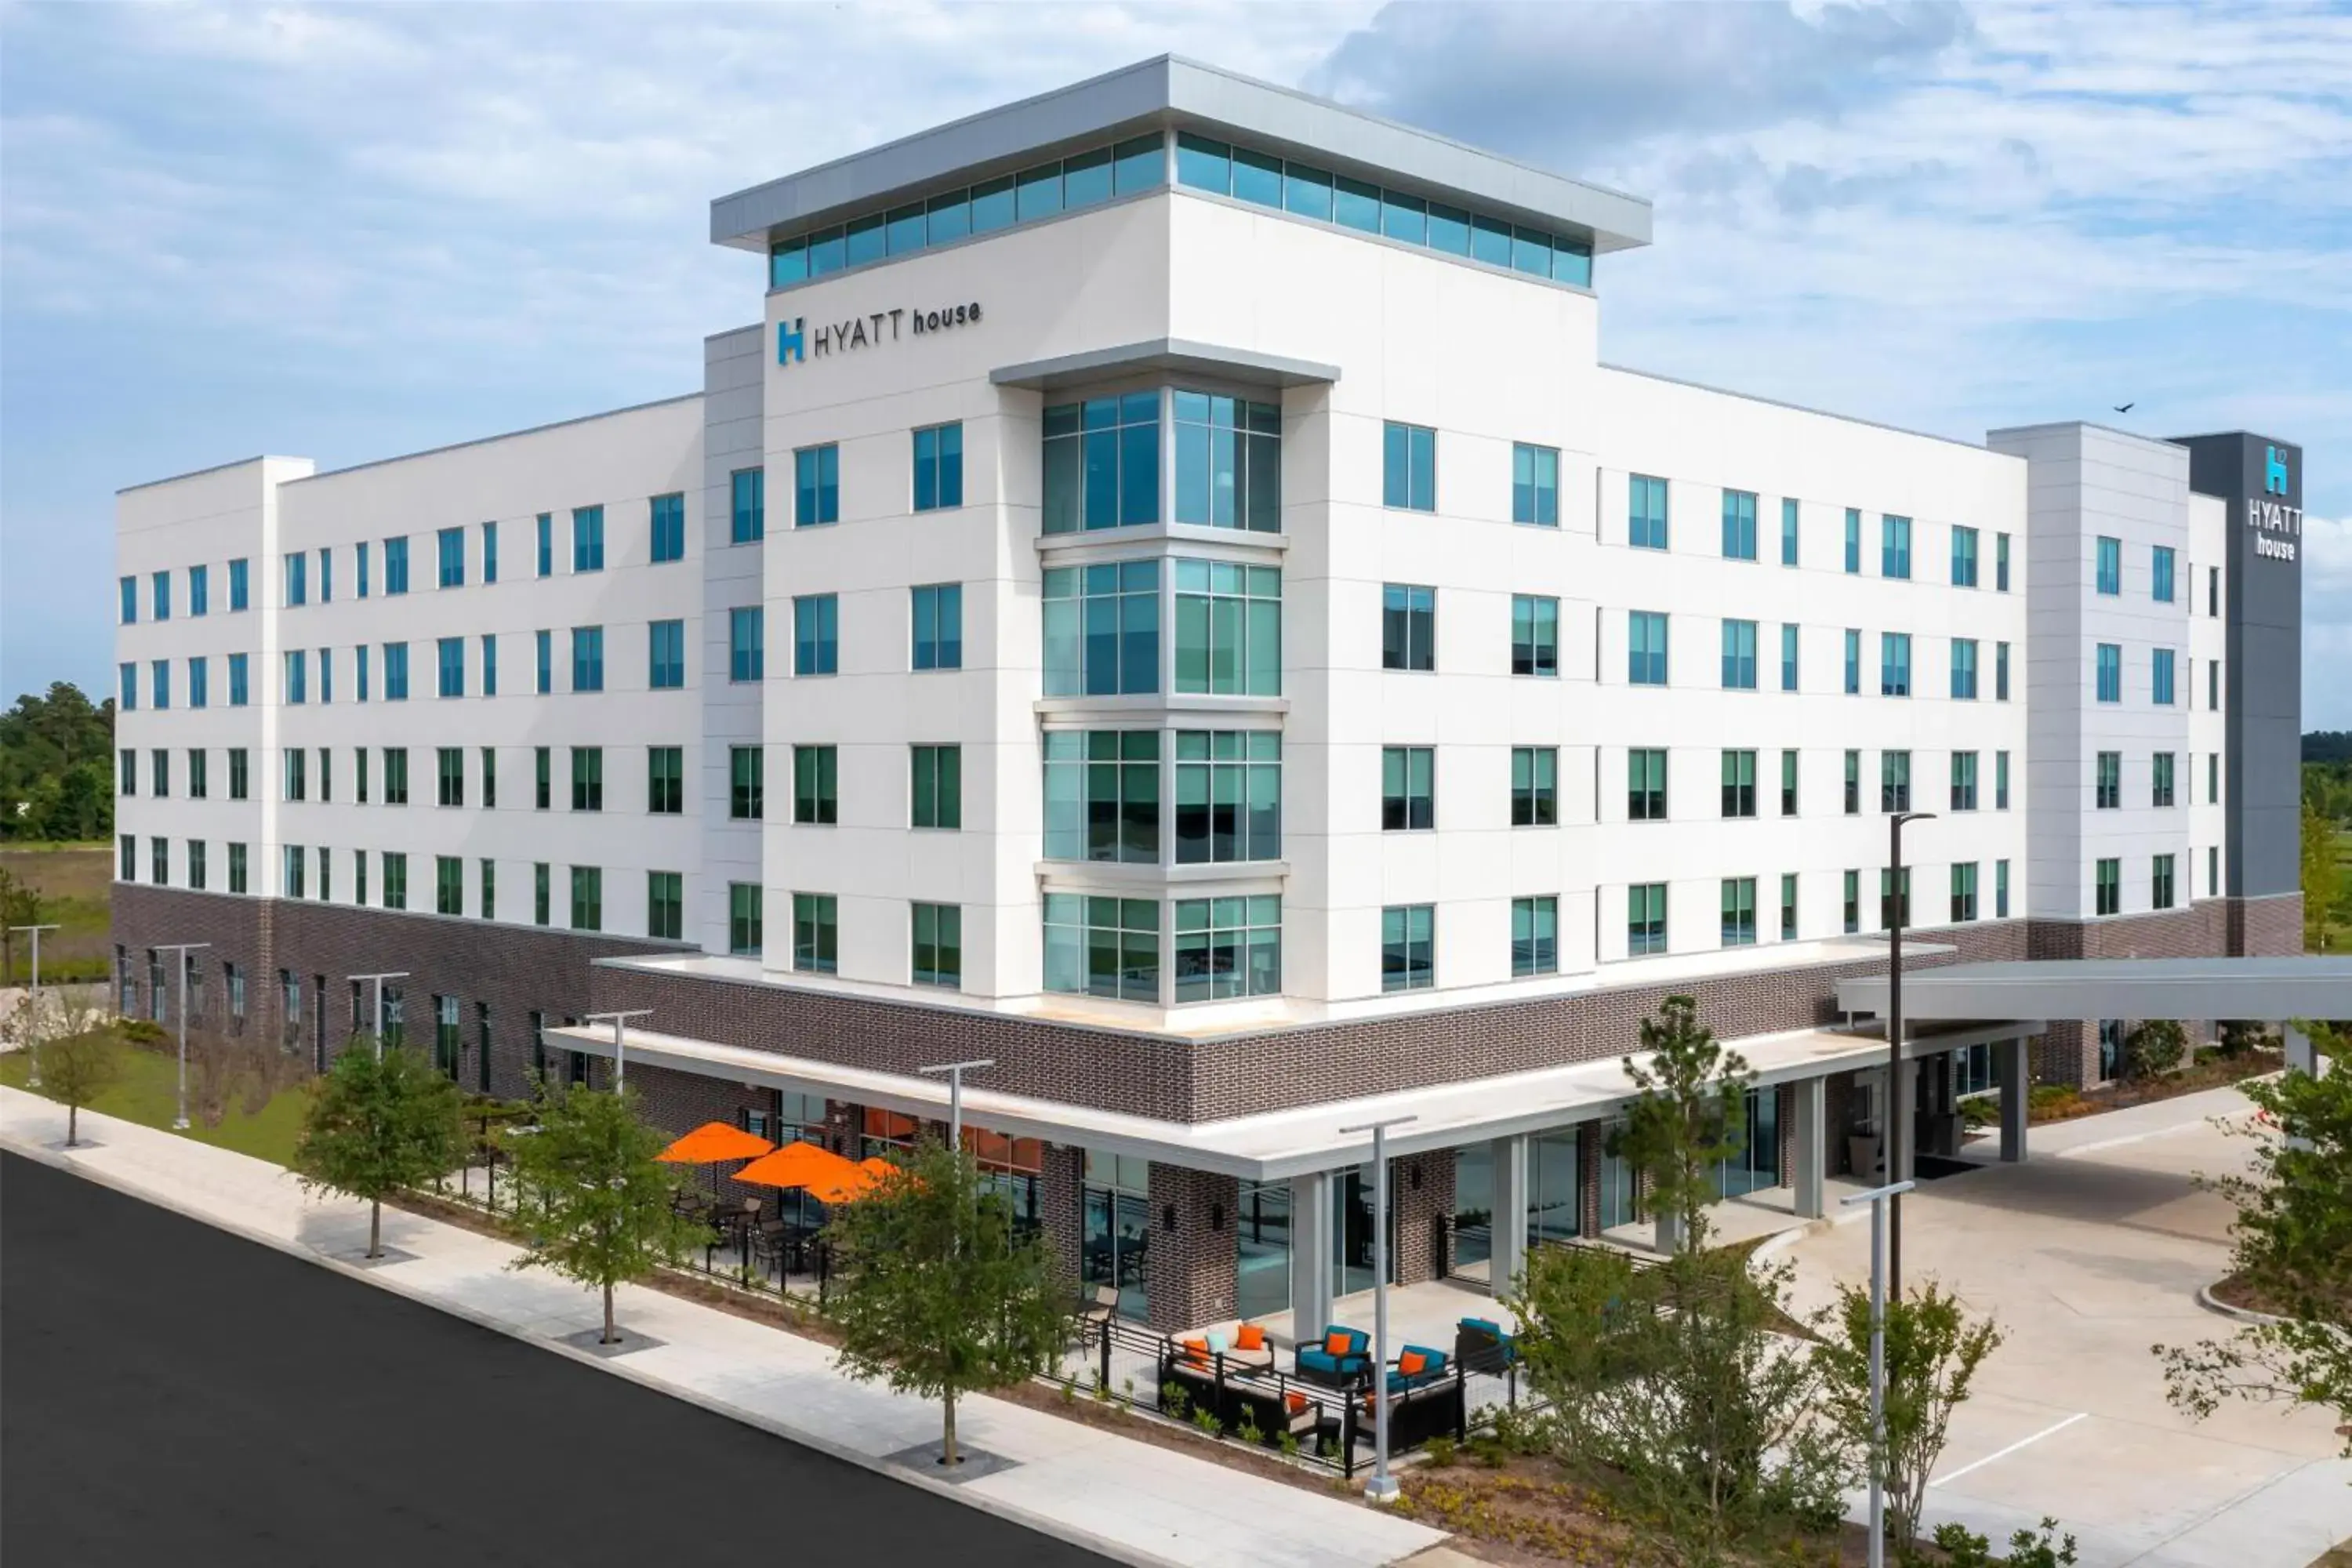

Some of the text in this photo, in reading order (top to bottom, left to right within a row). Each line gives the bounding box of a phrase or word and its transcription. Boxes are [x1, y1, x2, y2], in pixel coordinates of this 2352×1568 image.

[815, 309, 903, 357] HYATT
[913, 302, 981, 334] house
[2249, 499, 2302, 535] HYATT
[2257, 531, 2295, 561] house
